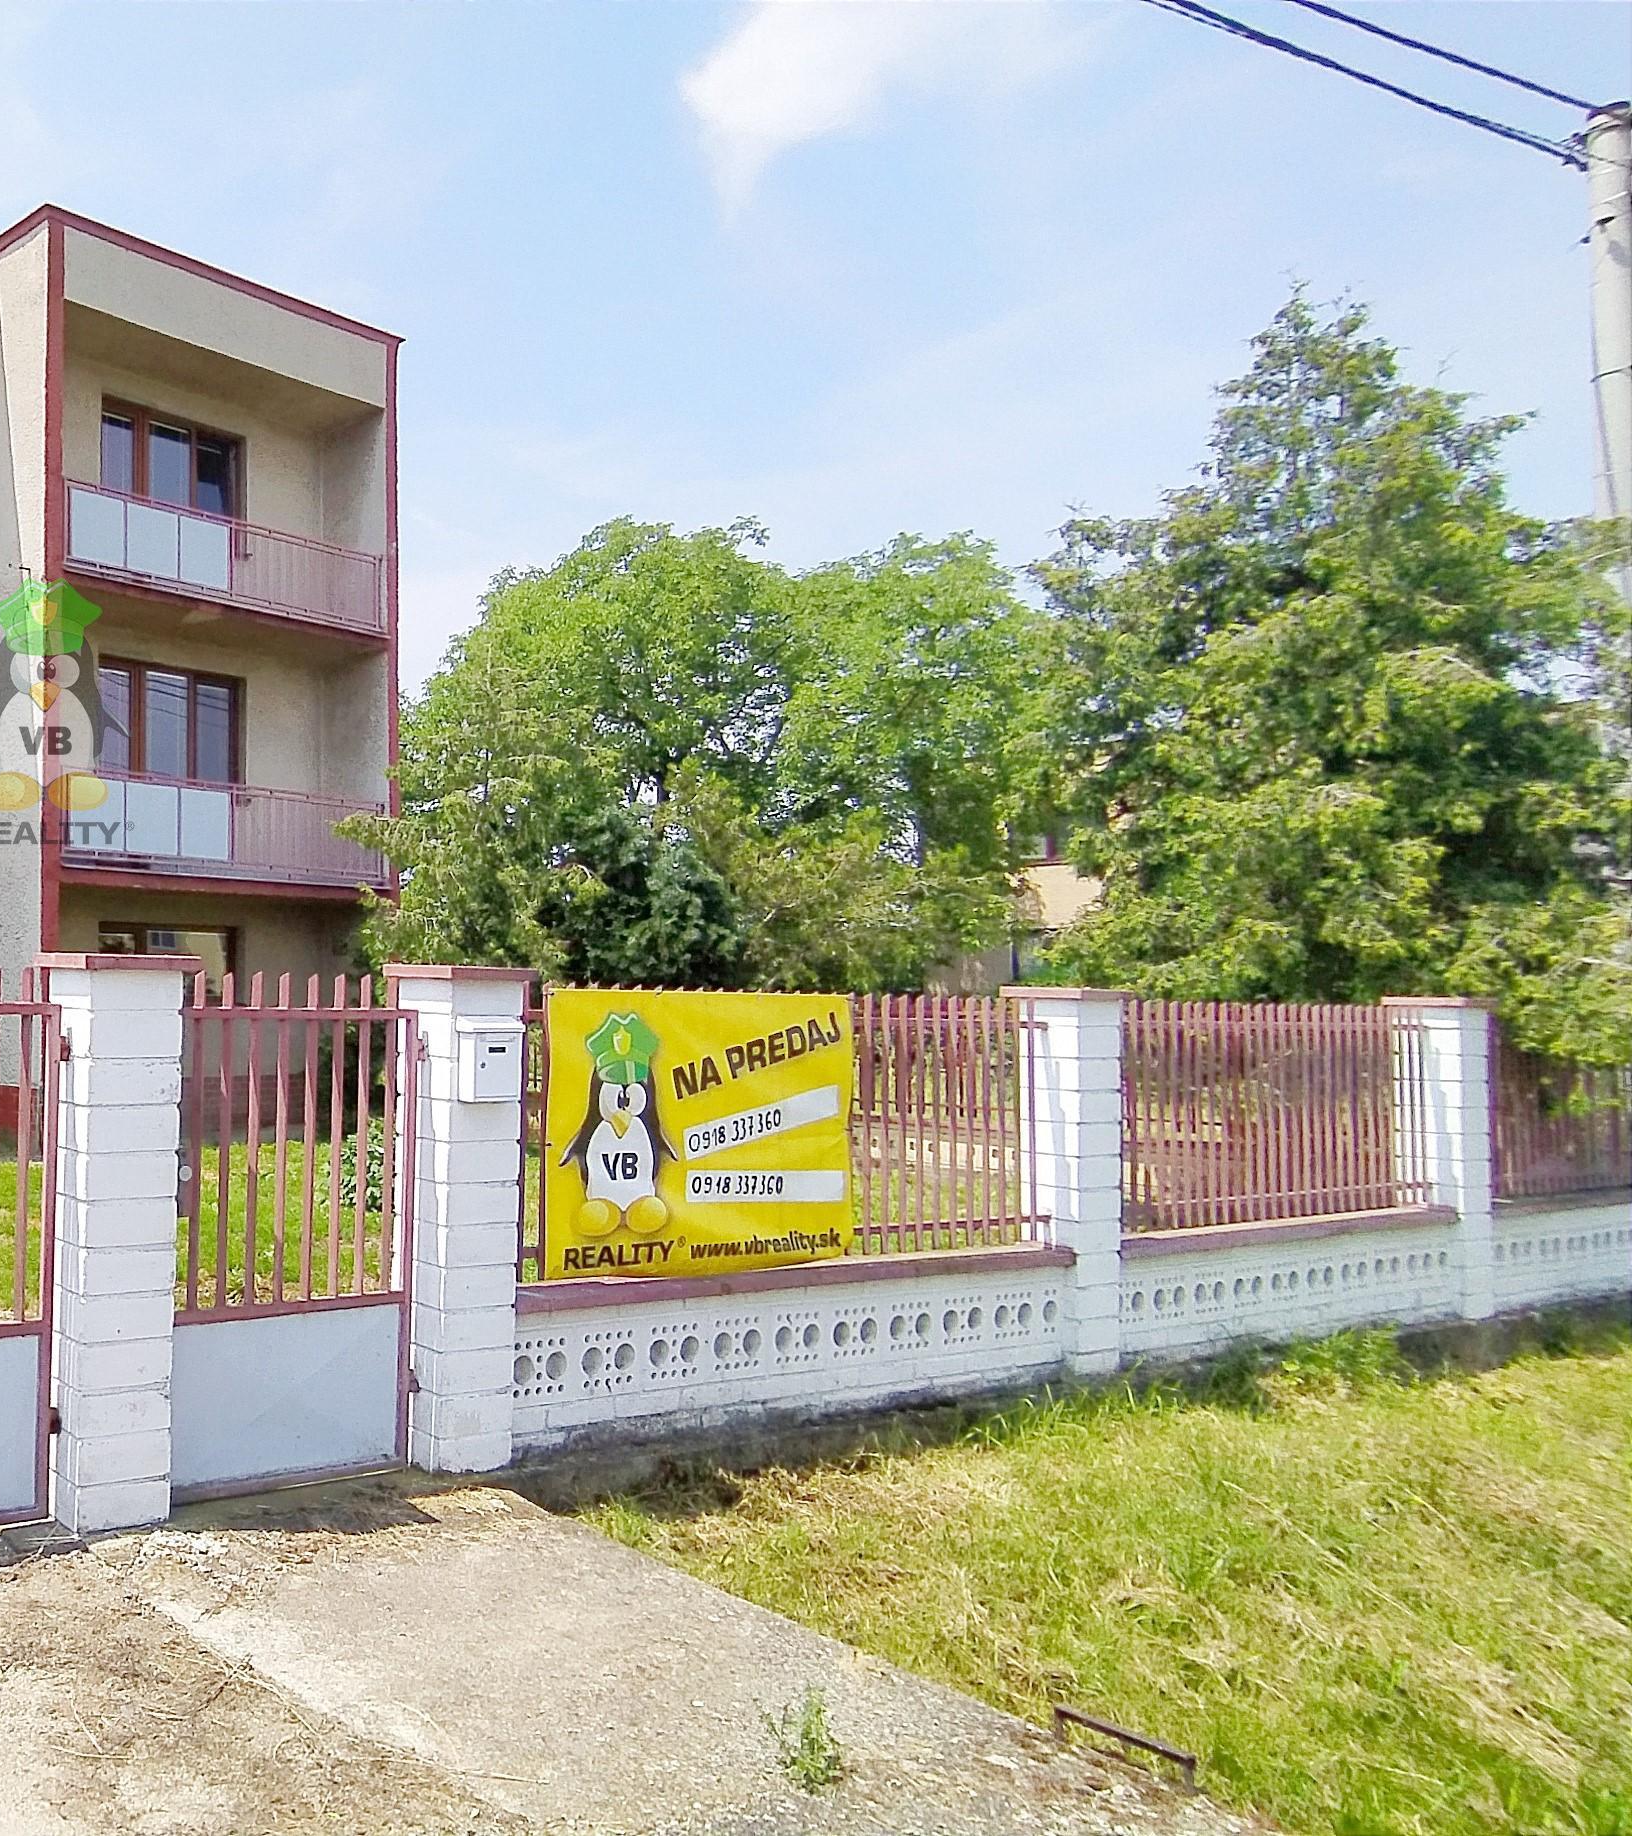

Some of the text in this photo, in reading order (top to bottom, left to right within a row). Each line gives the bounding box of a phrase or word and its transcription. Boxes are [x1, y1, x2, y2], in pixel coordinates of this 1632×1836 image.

[672, 1011, 841, 1100] NA PREDAJ
[688, 1109, 781, 1153] 0918 337360
[601, 1152, 638, 1181] VB
[691, 1175, 784, 1196] 0918 337360
[563, 1240, 675, 1271] REALITY
[690, 1228, 841, 1260] www.vbreality.sk
